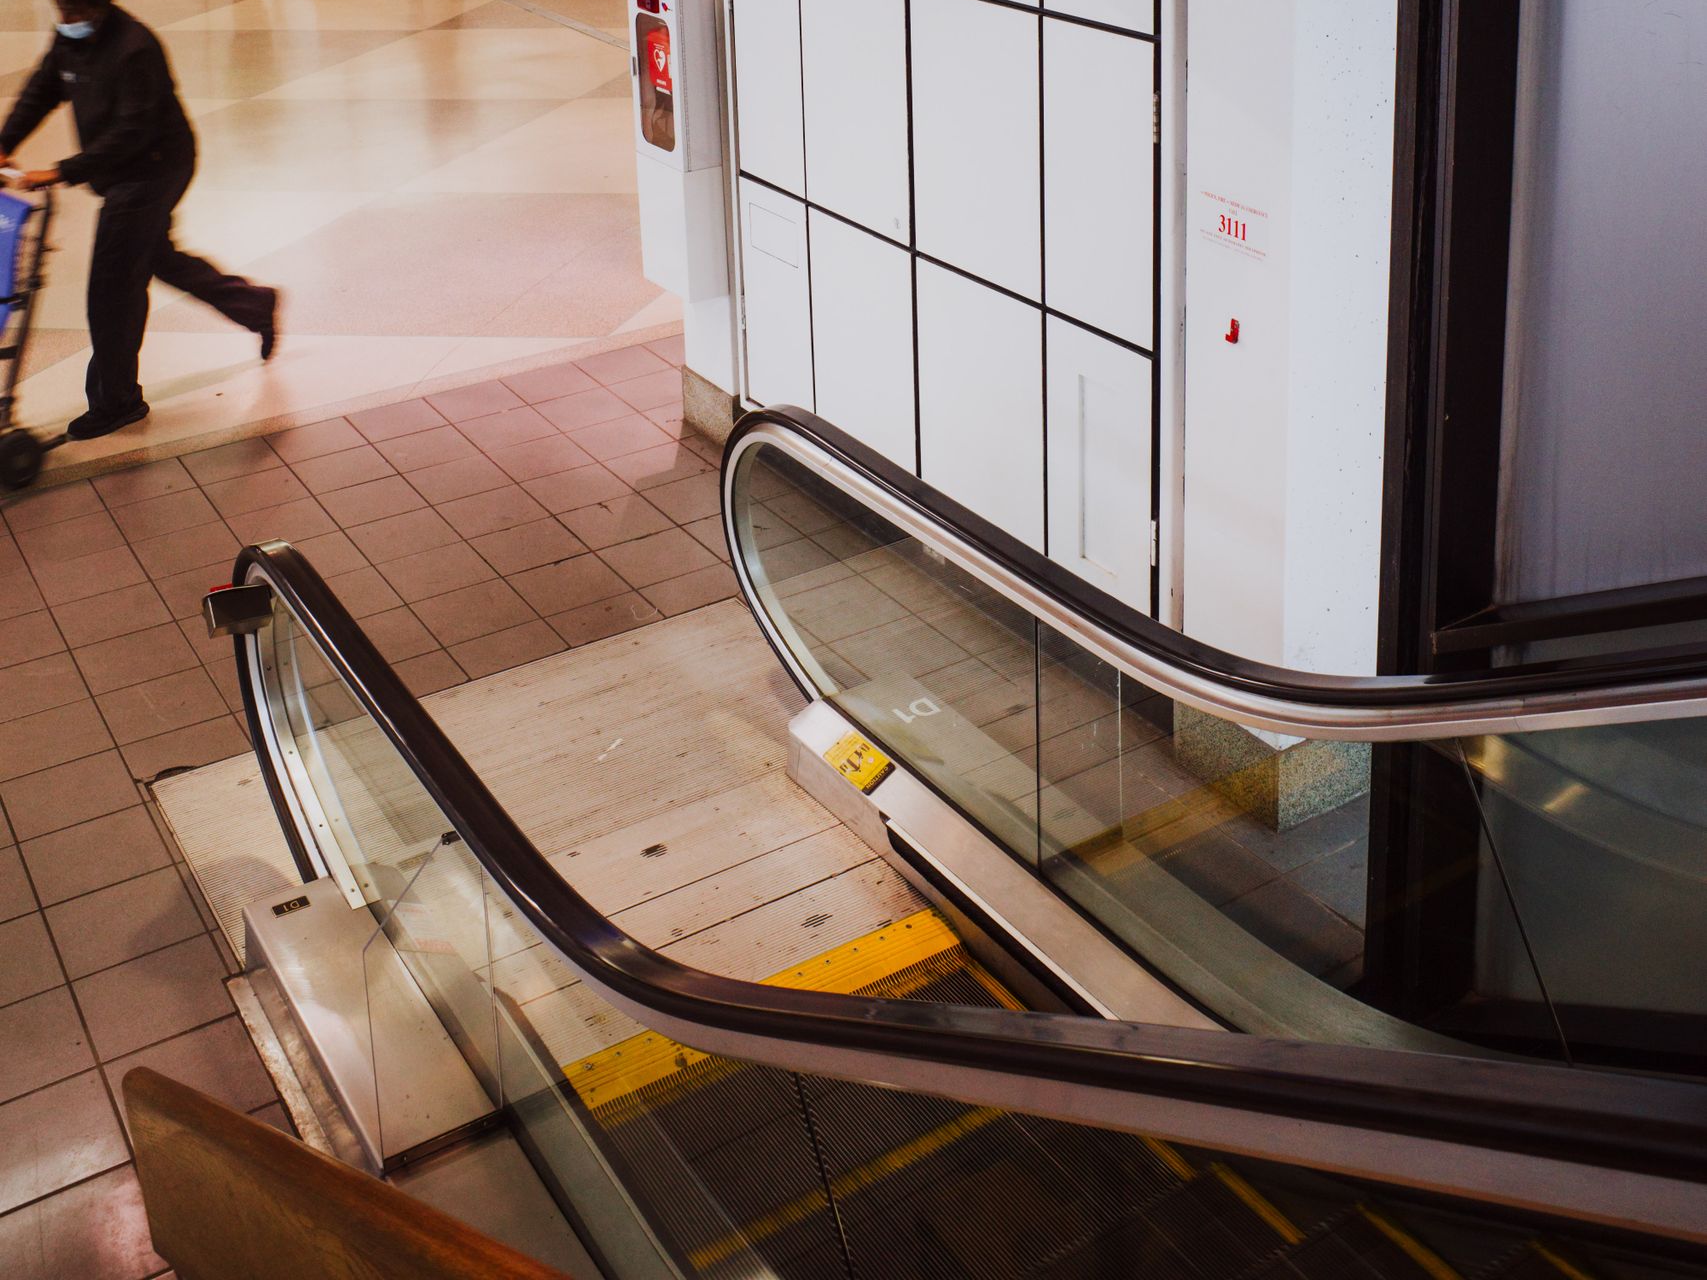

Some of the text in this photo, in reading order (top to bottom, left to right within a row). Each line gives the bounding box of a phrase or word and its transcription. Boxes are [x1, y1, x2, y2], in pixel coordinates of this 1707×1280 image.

[1218, 214, 1246, 241] 3111
[892, 697, 941, 724] D1
[865, 765, 890, 790] CAUTION
[282, 900, 301, 912] D1
